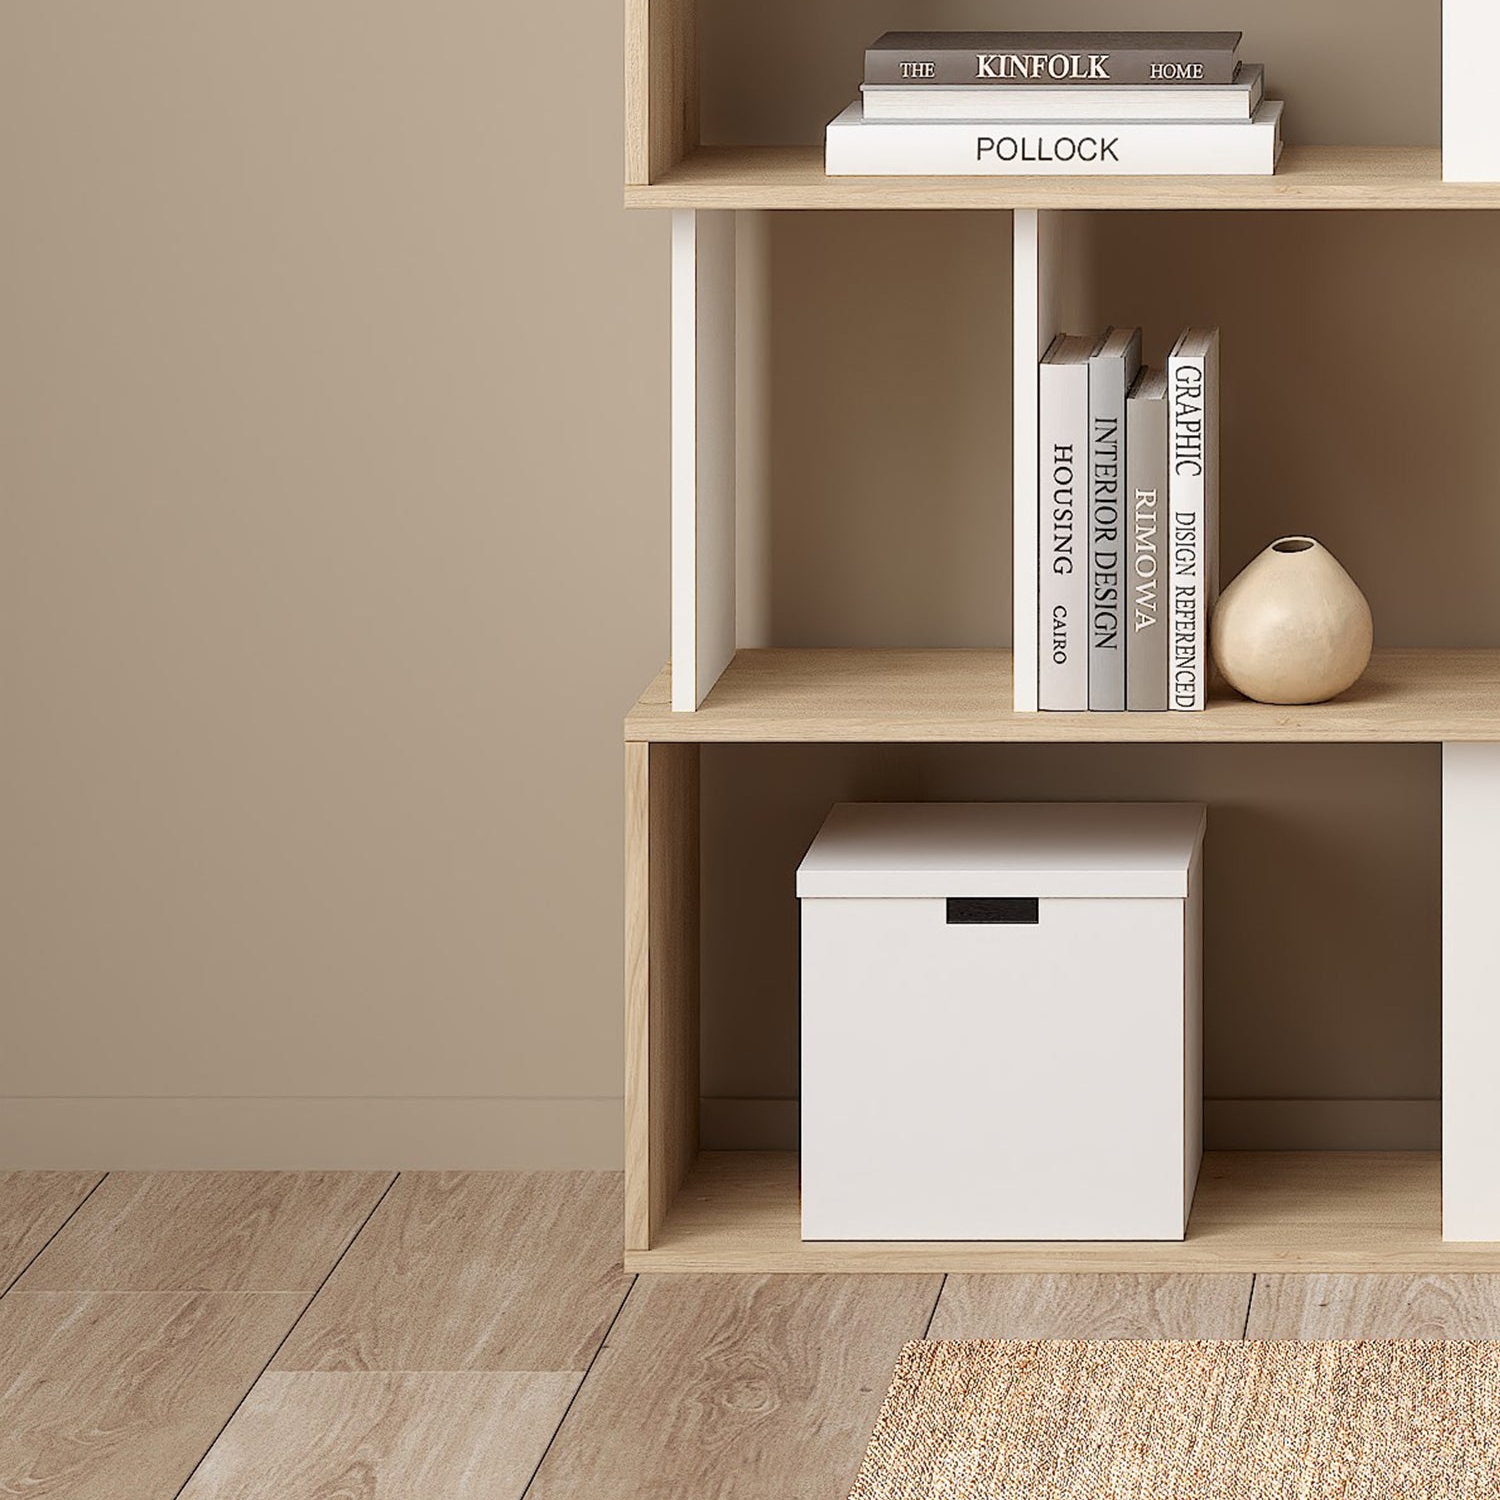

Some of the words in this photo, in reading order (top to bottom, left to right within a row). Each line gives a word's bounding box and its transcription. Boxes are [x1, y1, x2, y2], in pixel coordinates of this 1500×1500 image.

[899, 62, 936, 79] THE
[975, 54, 1110, 80] KINFOLK
[1150, 62, 1204, 80] HOME
[976, 137, 1119, 162] POLLOCK
[1175, 365, 1202, 477] GRAPHIC
[1053, 443, 1073, 575] HOUSING
[1094, 417, 1118, 543] INTERIOR
[1135, 488, 1157, 632] RIMOWA
[1175, 511, 1196, 577] DISIGN
[1052, 605, 1067, 665] CAIRO
[1094, 552, 1118, 650] DESIGN
[1175, 585, 1196, 709] REFERENCED
